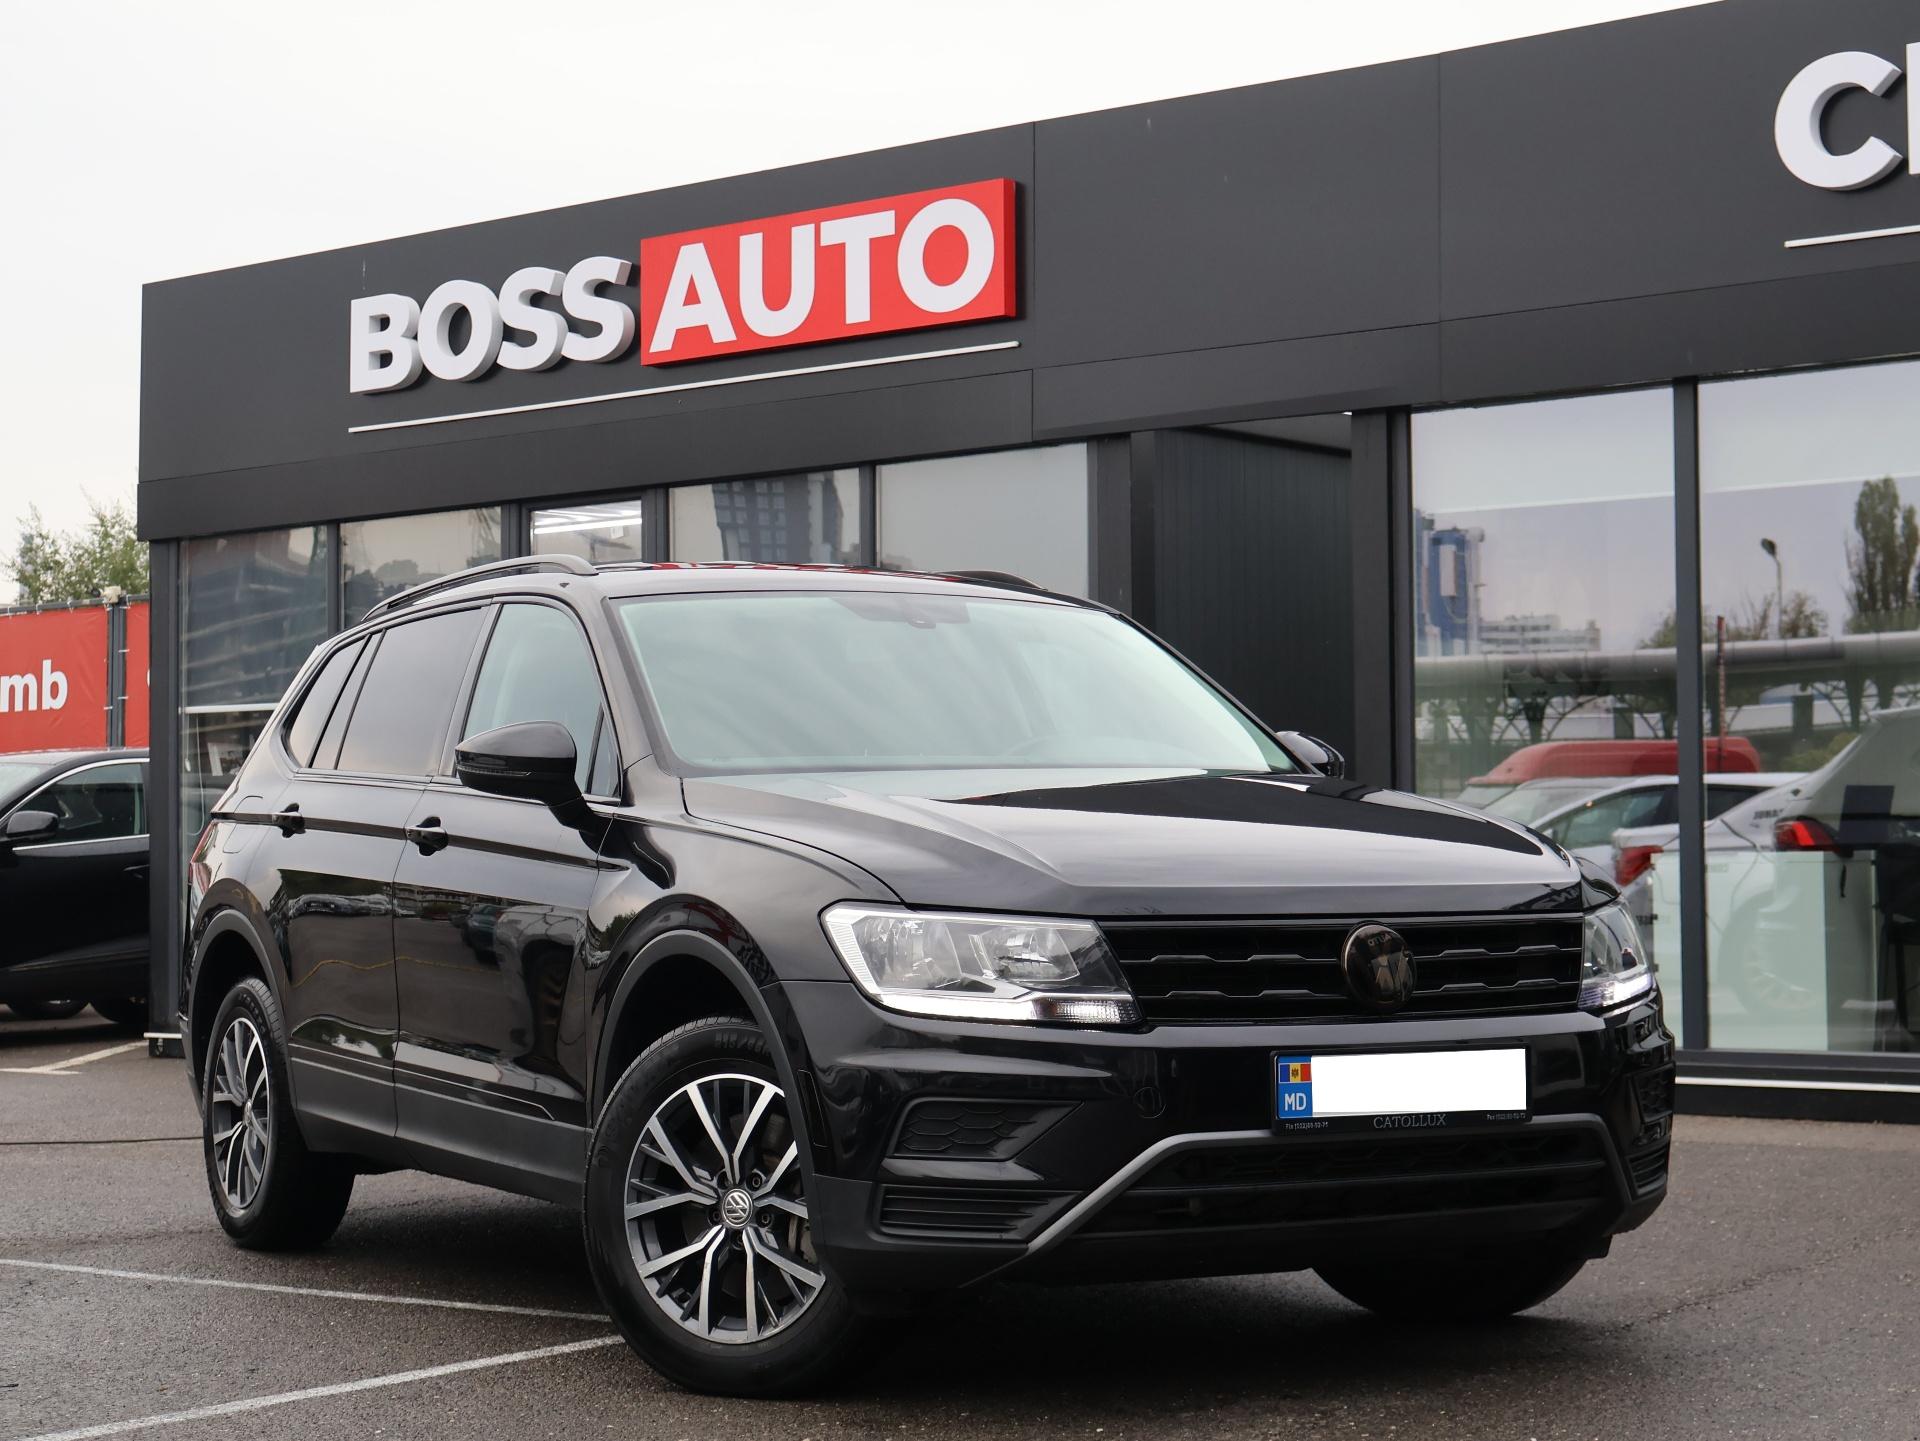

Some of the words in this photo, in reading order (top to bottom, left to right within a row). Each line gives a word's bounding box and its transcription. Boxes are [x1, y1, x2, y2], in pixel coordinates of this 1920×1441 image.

[1774, 41, 1920, 191] C
[350, 255, 635, 393] BOSS
[649, 198, 995, 353] AUTO
[1284, 1092, 1307, 1112] MD
[1373, 1113, 1447, 1129] CATOLLUX
